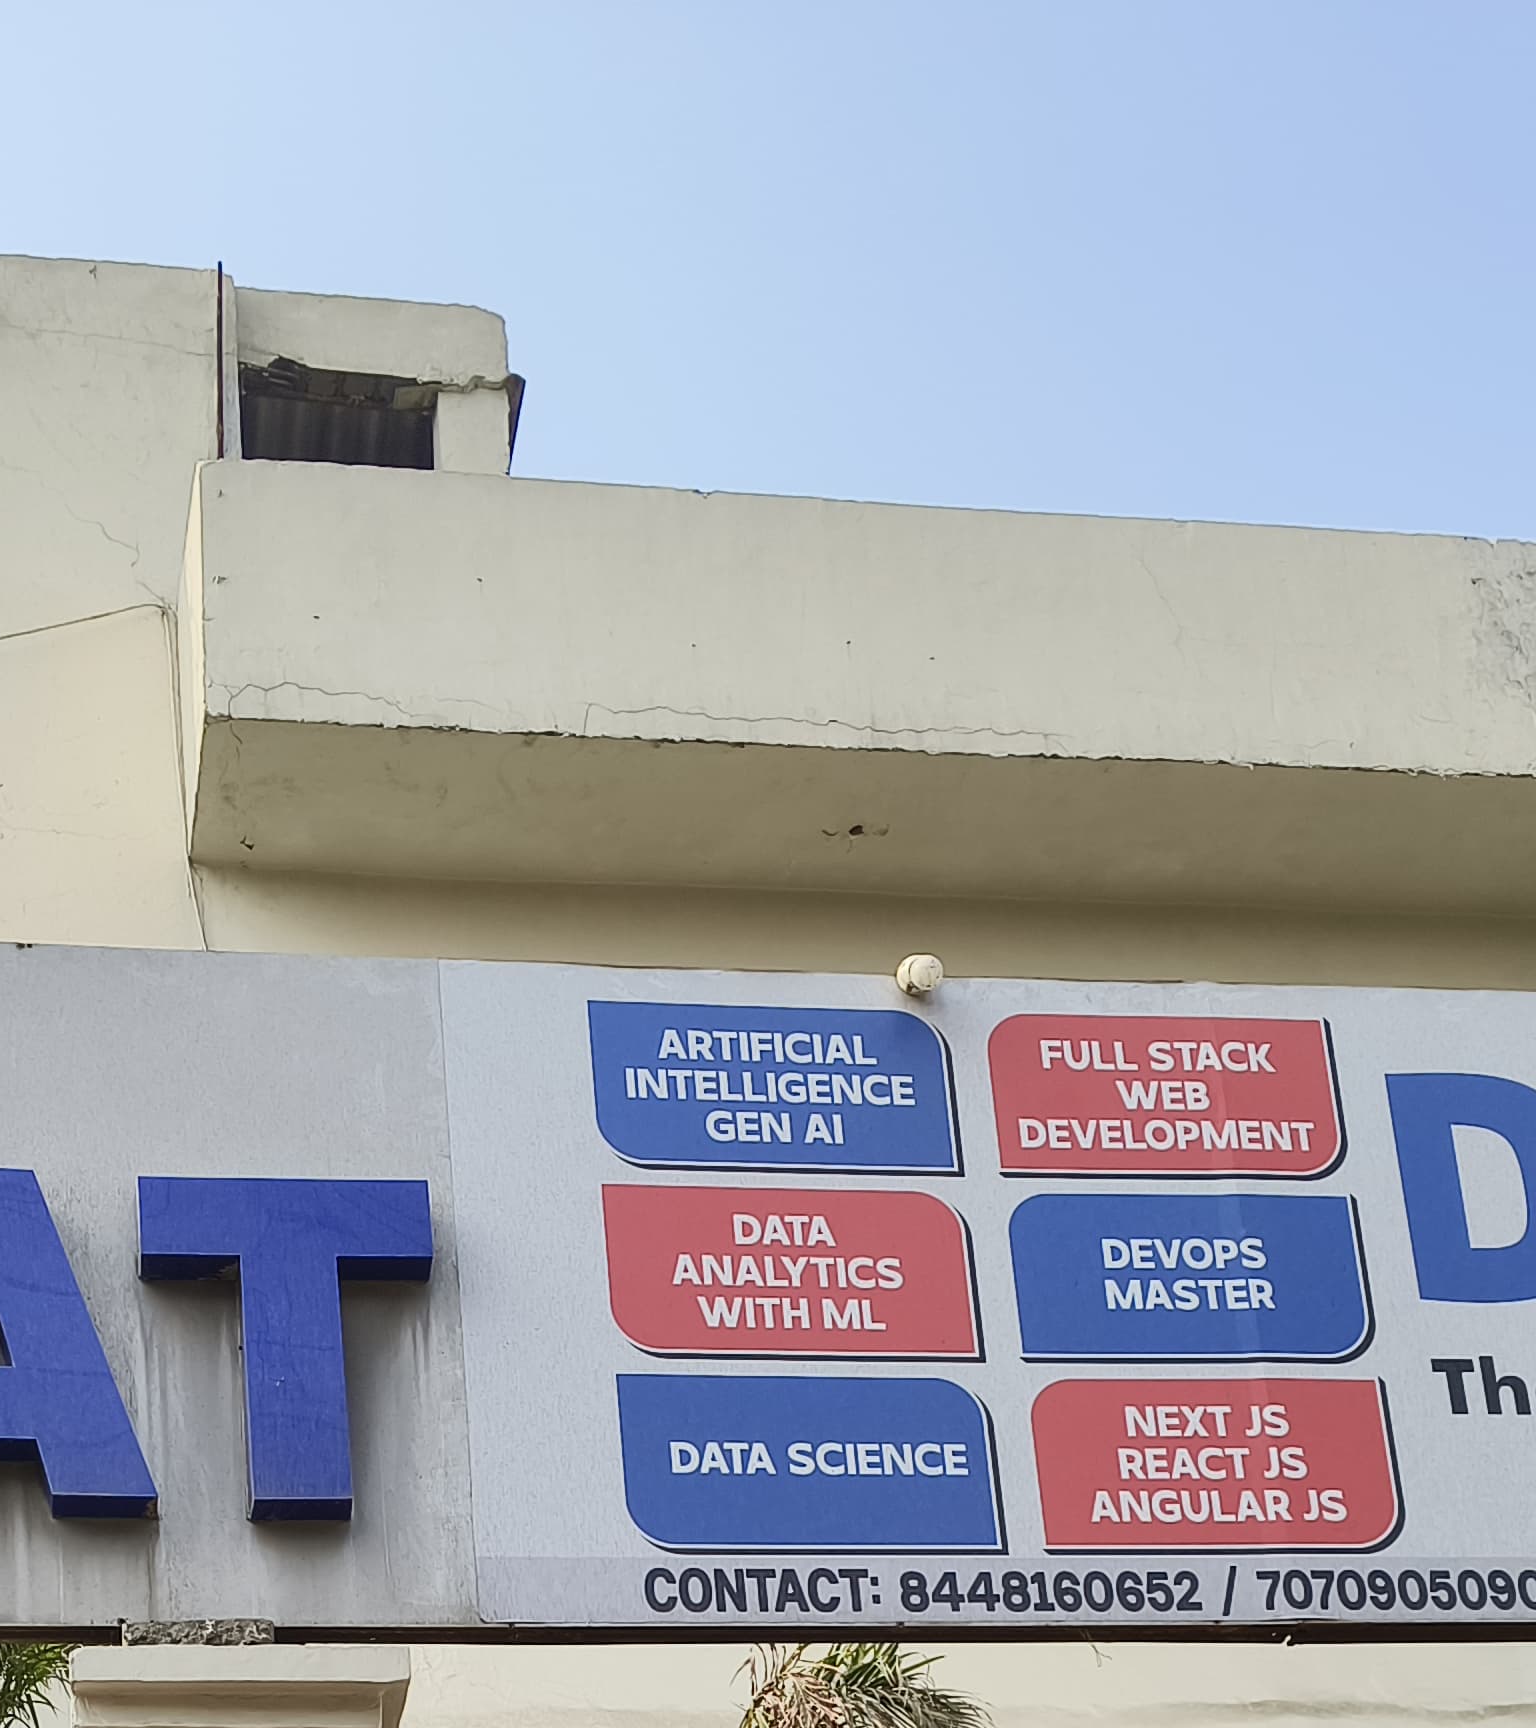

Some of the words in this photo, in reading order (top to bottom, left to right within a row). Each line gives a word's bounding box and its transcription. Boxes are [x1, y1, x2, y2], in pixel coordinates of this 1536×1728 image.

[658, 1027, 878, 1066] ARTIFICIAL
[1039, 1037, 1139, 1073] FULL
[1150, 1040, 1275, 1074] STACK
[624, 1066, 916, 1108] INTELLIGENCE
[1115, 1078, 1211, 1112] WEB
[704, 1108, 793, 1145] GEN
[804, 1113, 844, 1146] AI
[1019, 1117, 1315, 1154] DEVELOPMENT
[732, 1212, 836, 1248] DATA
[672, 1254, 904, 1291] ANALYTICS
[1102, 1237, 1267, 1272] DEVOPS
[696, 1294, 810, 1330] WITH
[823, 1297, 887, 1332] ML
[1105, 1277, 1276, 1312] MASTER
[1124, 1403, 1232, 1439] NEXT
[1245, 1404, 1290, 1439] JS
[669, 1440, 776, 1477] DATA
[788, 1440, 970, 1478] SCIENCE
[1117, 1446, 1250, 1480] REACT
[1263, 1447, 1308, 1481] JS
[1091, 1488, 1293, 1523] ANGULAR
[1304, 1490, 1348, 1524] JS
[644, 1567, 881, 1614] CONTACT:
[898, 1568, 1201, 1614] 8448160652
[1222, 1568, 1236, 1617] /
